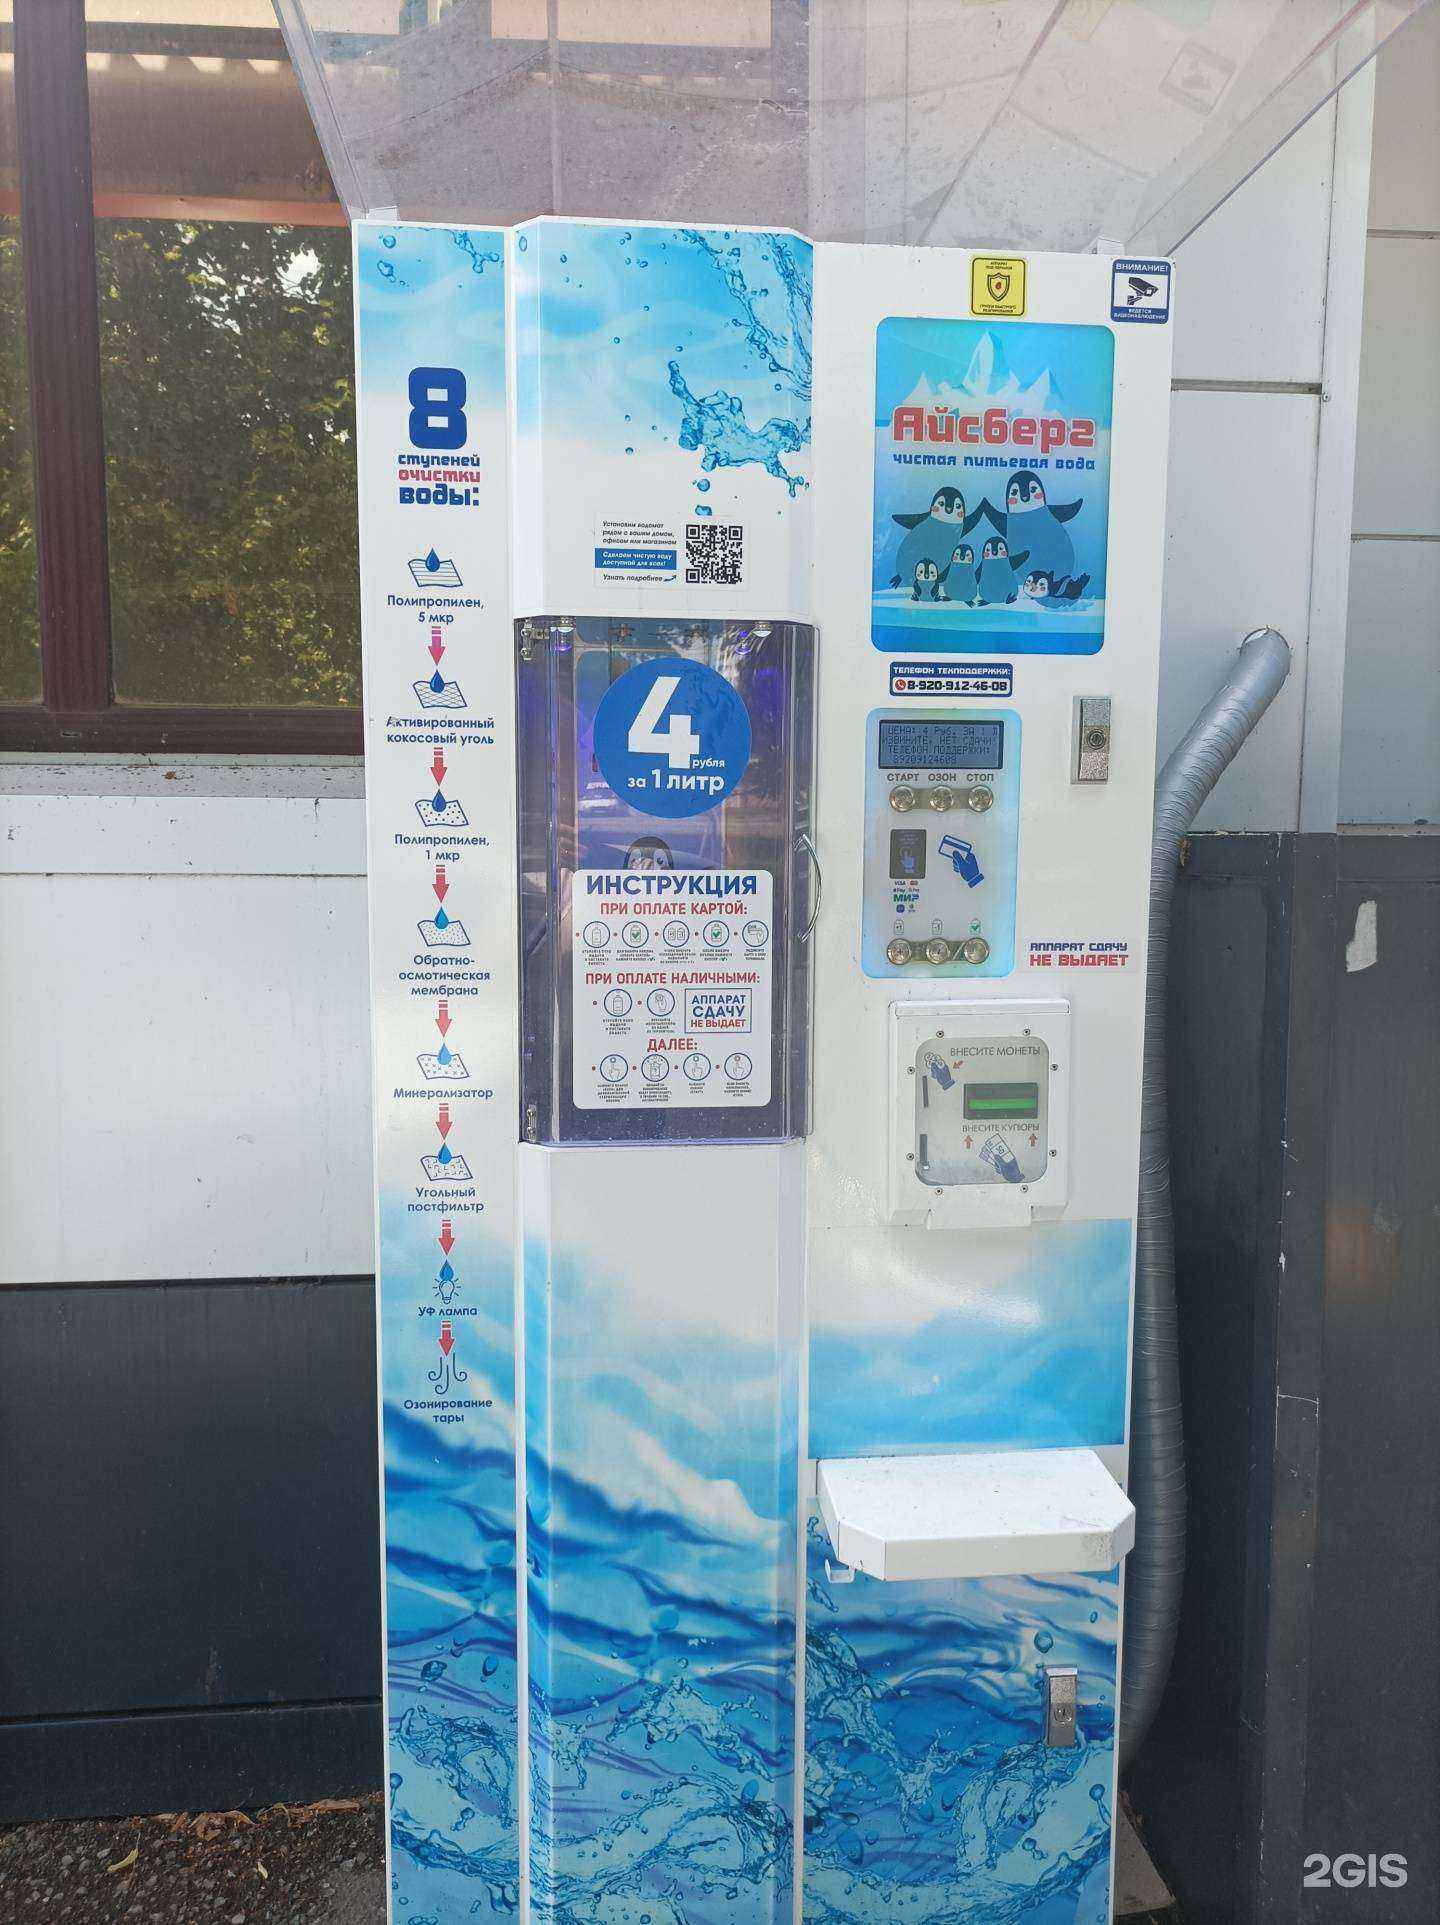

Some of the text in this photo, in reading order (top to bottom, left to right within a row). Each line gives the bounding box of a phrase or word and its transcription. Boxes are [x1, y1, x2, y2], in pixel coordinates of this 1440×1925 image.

[1115, 263, 1168, 272] ВНИМАНИЕ!
[408, 367, 467, 449] 8
[893, 405, 1095, 453] Айсберг
[398, 453, 480, 467] ступеней
[893, 453, 1096, 470] чистая питьевая вода
[398, 469, 480, 483] очистки
[399, 484, 479, 506] воды:
[387, 595, 484, 609] Полипропилен,
[418, 613, 454, 625] 5 мкр
[938, 667, 1011, 675] ТЕХПОДДЕРЖКИ:
[907, 680, 1008, 691] 8-920-912-46-08
[386, 716, 494, 730] Активированный
[628, 676, 700, 769] 4
[387, 733, 494, 746] кокосовый уголь
[692, 758, 725, 770] рубля
[627, 769, 725, 795] за 1 литр
[887, 773, 994, 782] СТАРТ ОЗОН СТОП
[395, 834, 490, 847] Полипропилен,
[426, 850, 460, 863] 1 мкр
[586, 875, 757, 898] ИНСТРУКЦИЯ
[893, 894, 920, 902] МИР
[600, 900, 748, 915] ПРИ ОПЛАТЕ КАРТОЙ:
[1030, 942, 1128, 951] АППАРАТ СДАЧУ
[414, 955, 475, 967] Обратно-
[1030, 954, 1129, 967] НЕ ВЫДАЕТ
[399, 972, 490, 981] осмотическая
[585, 972, 760, 985] ПРИ ОПЛАТЕ НАЛИЧНЫМИ:
[411, 986, 478, 998] мембрана
[691, 994, 746, 1005] АППАРАТ
[693, 1006, 745, 1019] СДАЧУ
[691, 1019, 746, 1028] НЕ ВЫДАЕТ
[647, 1038, 698, 1052] ДАЛЕЕ:
[950, 1046, 1041, 1056] ВНЕСИТЕ МОНЕТЫ
[393, 1088, 493, 1100] Минерализатор
[962, 1123, 1040, 1132] ВНЕСИТЕ КУПЮРЫ
[415, 1187, 475, 1199] Угольный
[408, 1201, 484, 1214] постфильтр
[418, 1306, 477, 1318] УФ лампа
[404, 1399, 493, 1411] Озонирование
[433, 1414, 465, 1425] тары
